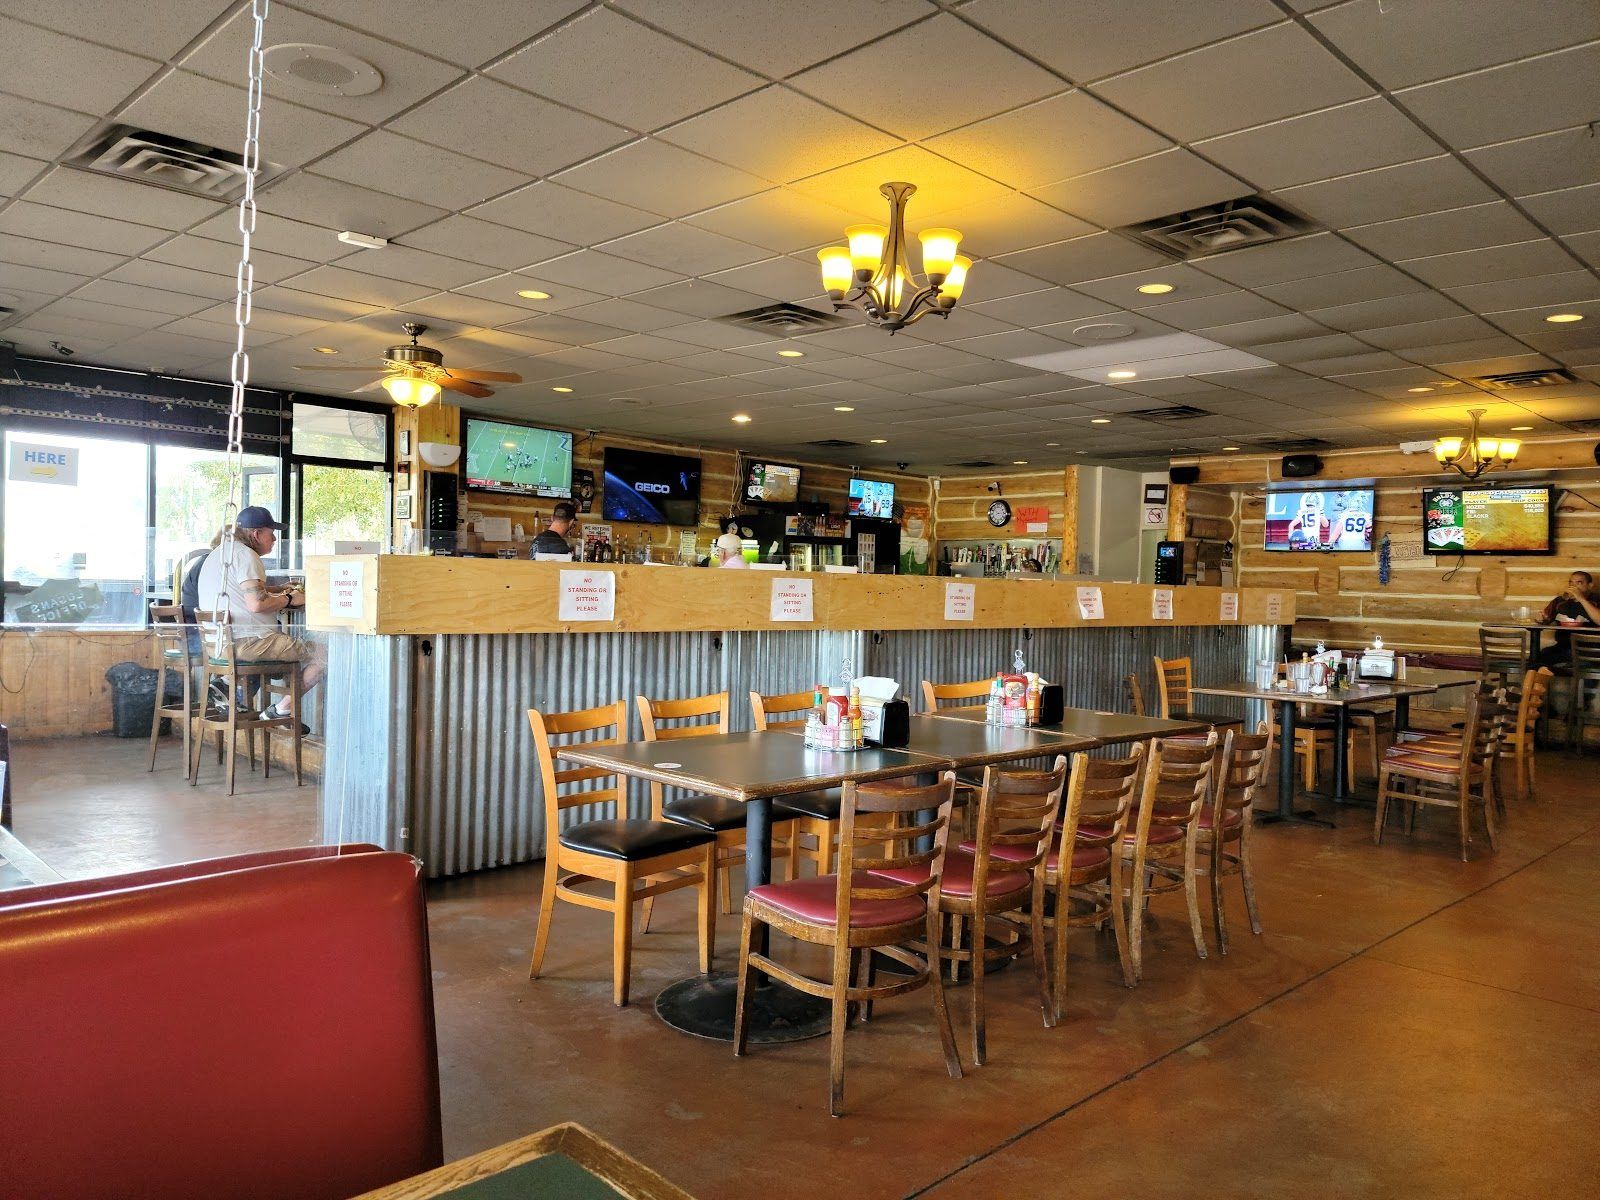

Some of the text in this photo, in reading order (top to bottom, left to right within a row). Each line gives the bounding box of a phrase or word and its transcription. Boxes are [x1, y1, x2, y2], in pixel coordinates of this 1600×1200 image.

[24, 450, 66, 465] HERE
[634, 482, 670, 494] GEICO
[1302, 514, 1316, 528] 15
[1345, 517, 1366, 533] 69
